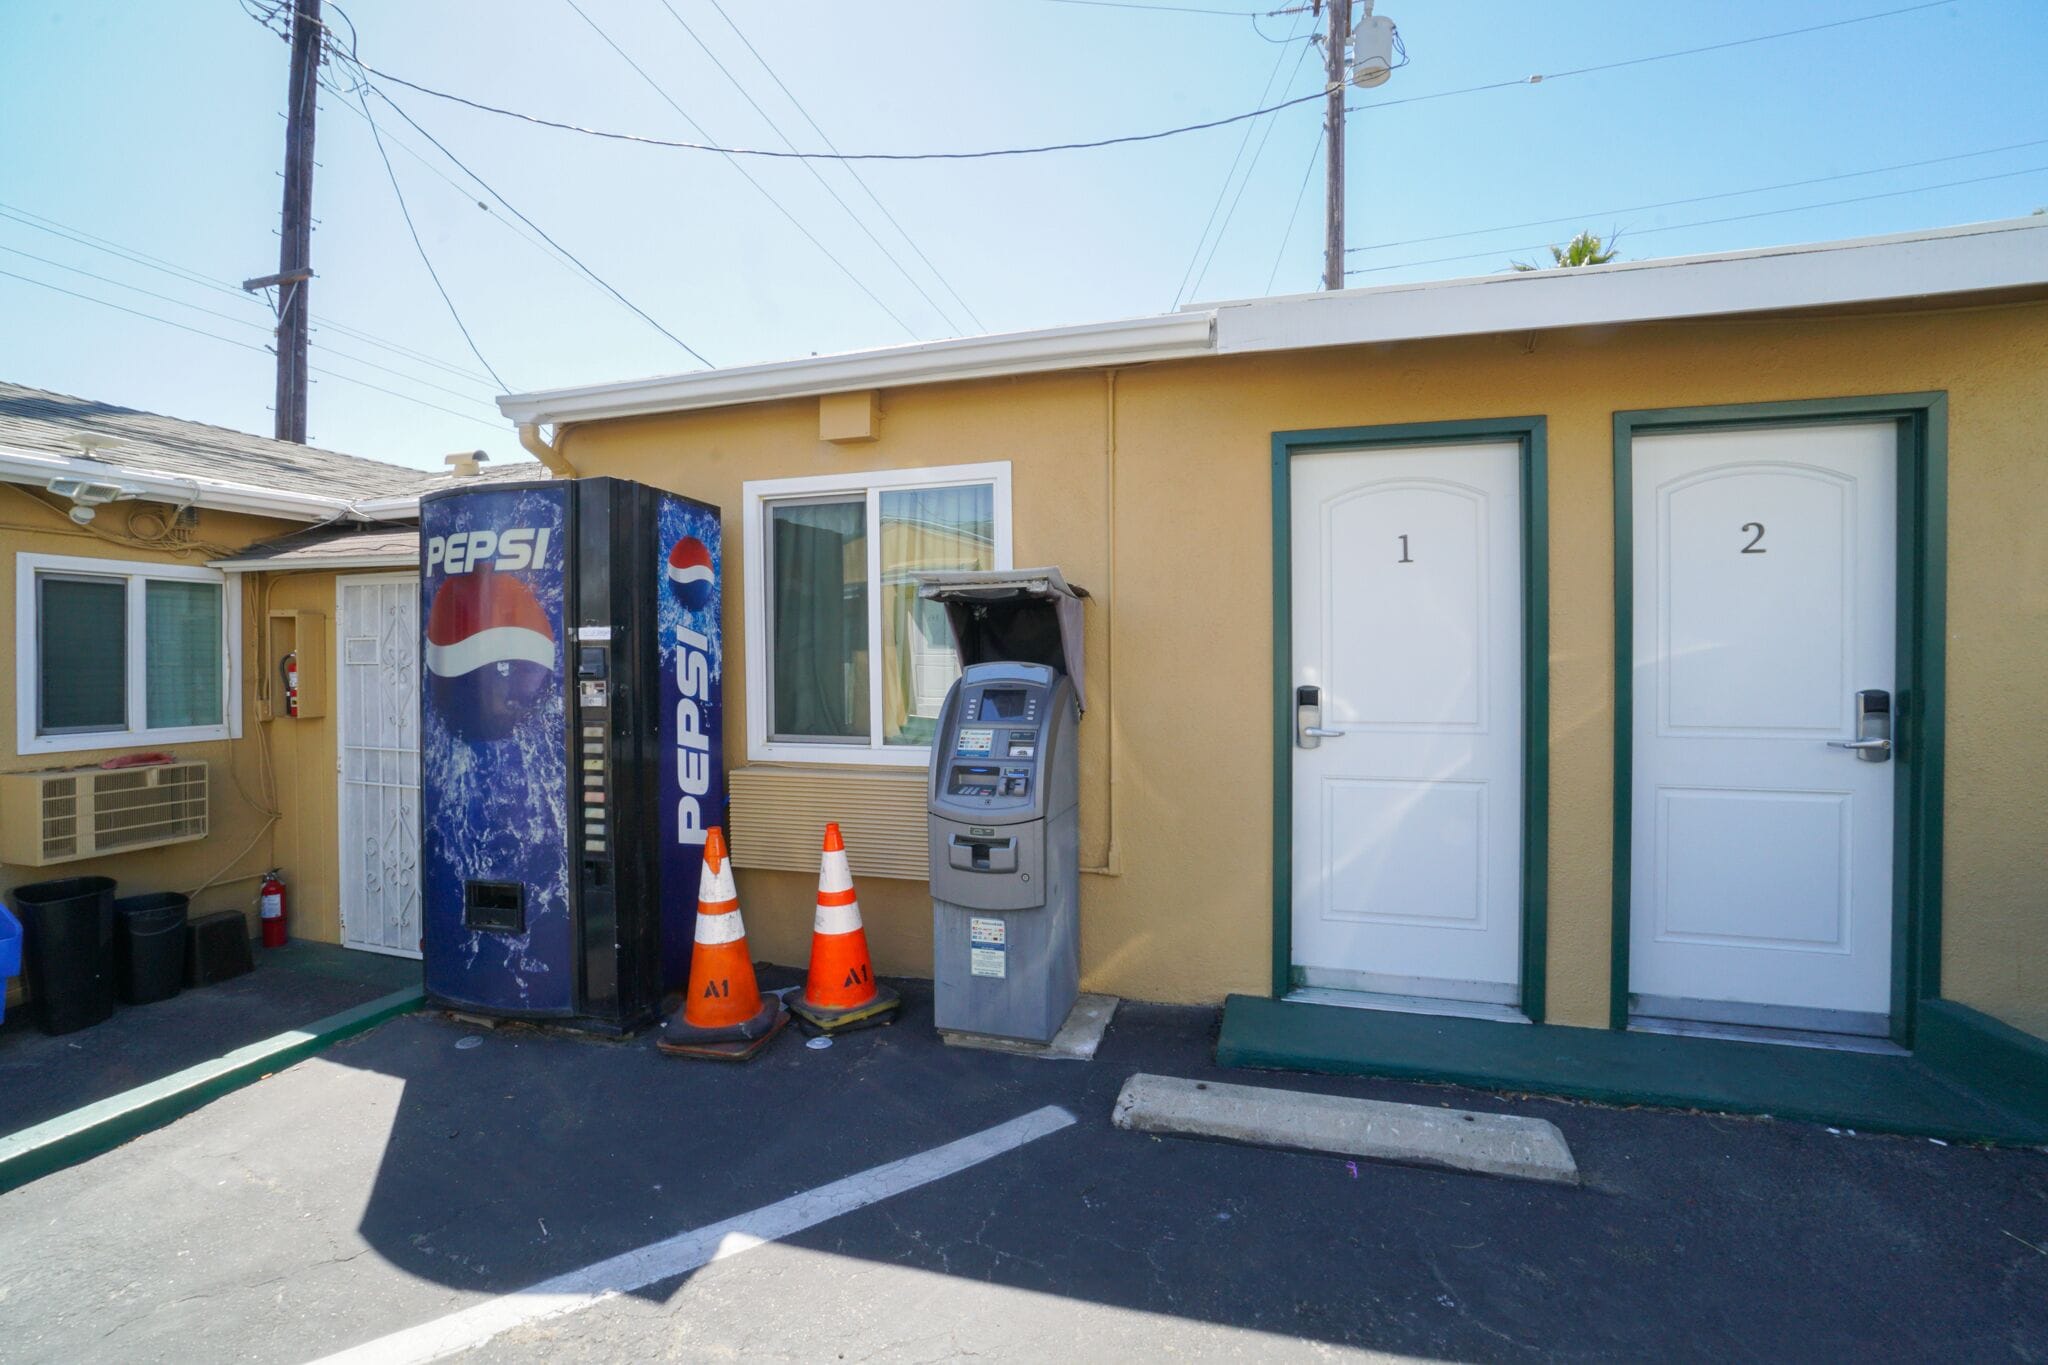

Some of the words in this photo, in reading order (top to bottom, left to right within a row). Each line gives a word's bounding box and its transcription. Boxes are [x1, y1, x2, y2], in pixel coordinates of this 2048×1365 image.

[426, 527, 550, 577] PEPSI
[1397, 534, 1415, 563] 1
[1740, 522, 1767, 554] 2
[676, 623, 710, 845] PEPSI
[703, 979, 729, 998] A1
[844, 963, 869, 988] A1
